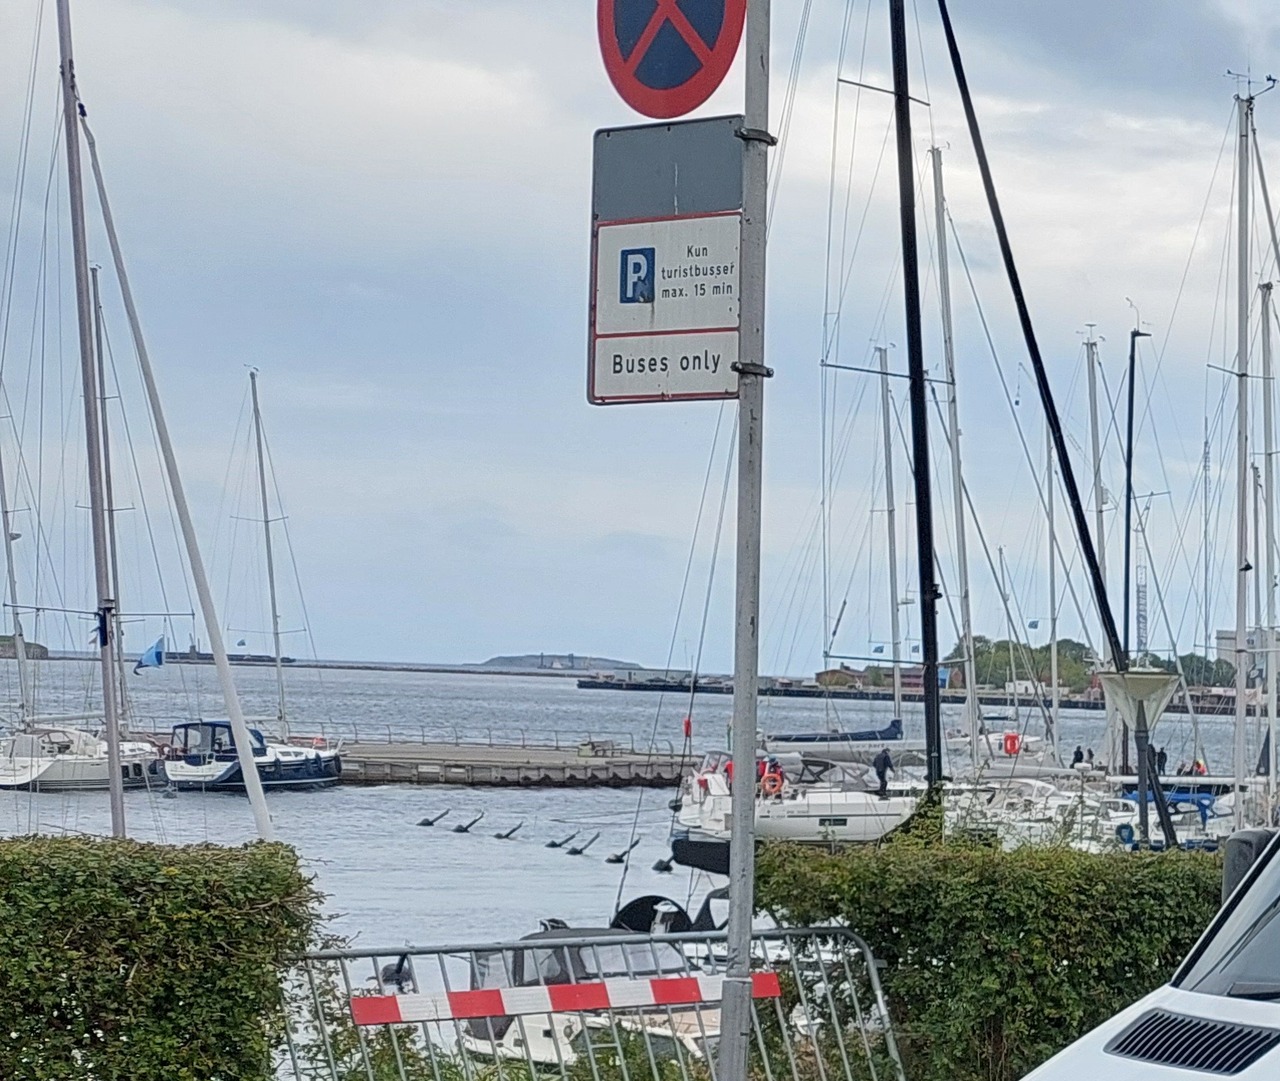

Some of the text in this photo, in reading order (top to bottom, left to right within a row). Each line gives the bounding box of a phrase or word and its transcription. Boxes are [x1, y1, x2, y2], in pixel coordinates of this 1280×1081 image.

[686, 245, 708, 258] Kun
[661, 261, 735, 281] turistbusser
[661, 282, 733, 299] max. 15 min
[612, 350, 721, 375] Buses only
